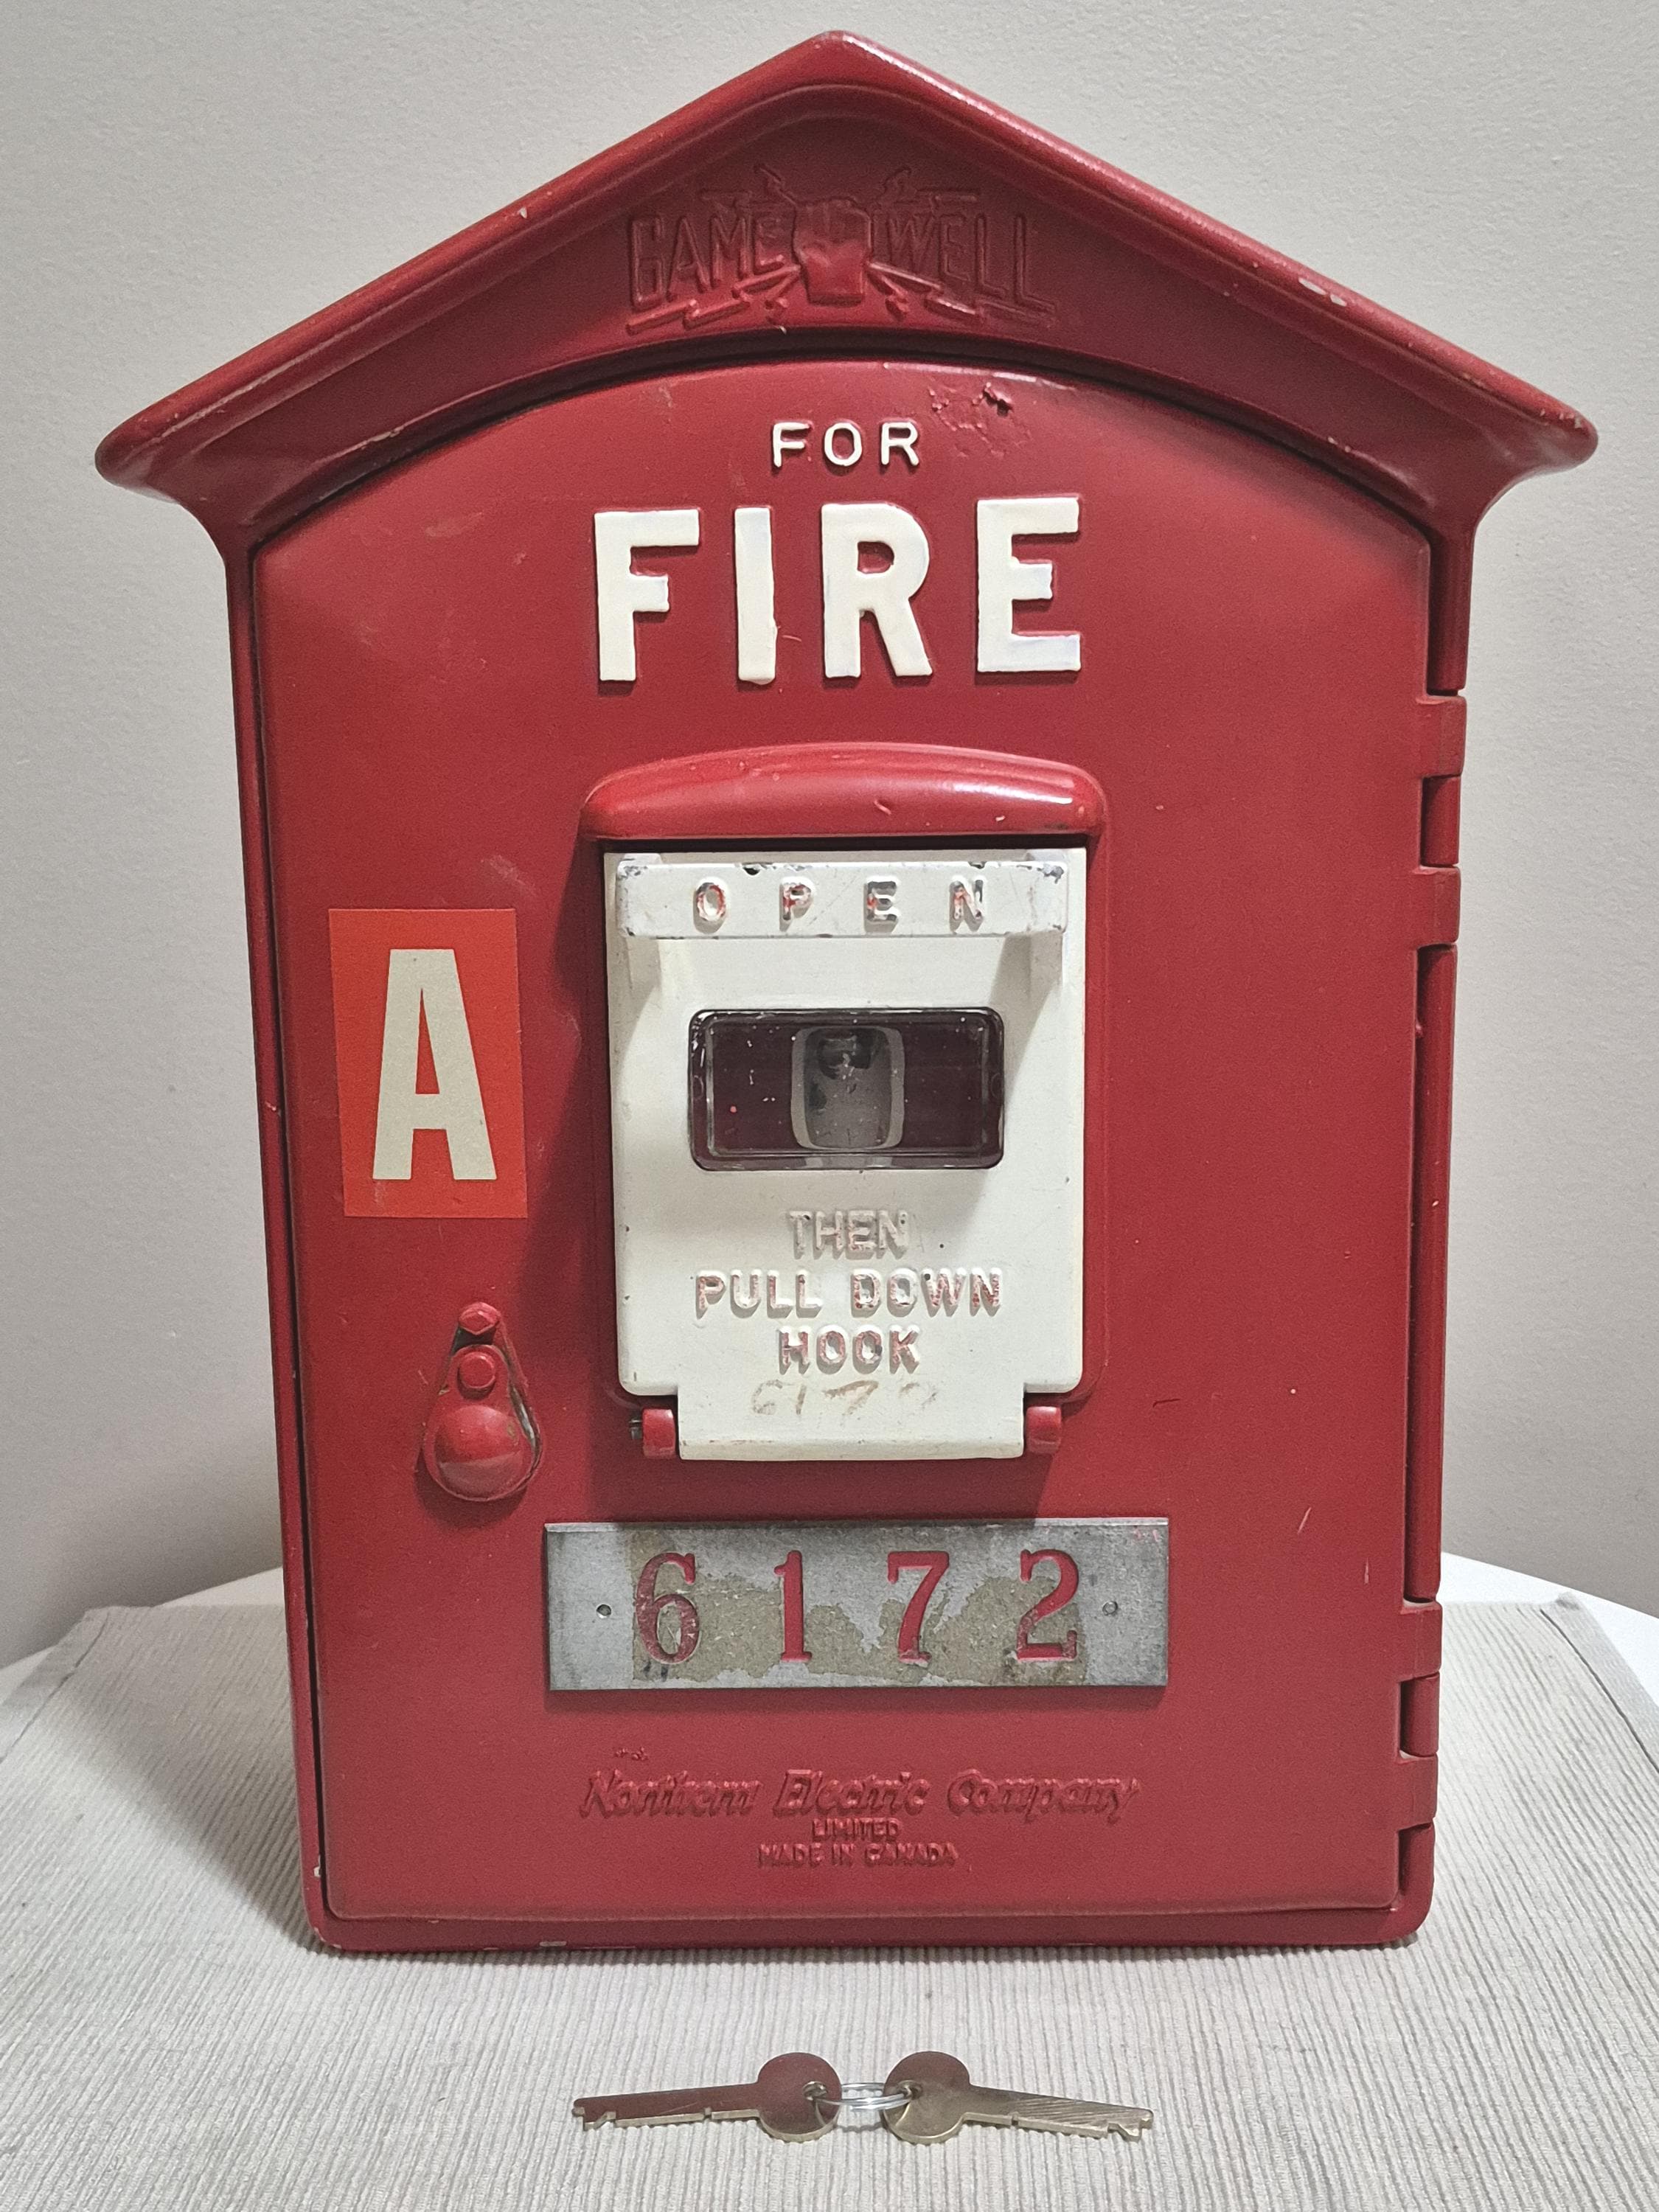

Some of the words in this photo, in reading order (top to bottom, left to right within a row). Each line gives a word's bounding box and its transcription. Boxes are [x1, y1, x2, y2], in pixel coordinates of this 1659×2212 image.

[771, 422, 921, 468] FOR
[594, 493, 1082, 684] FIRE
[693, 877, 985, 932] OPEN
[372, 948, 498, 1180] A
[787, 1209, 910, 1258] THEN
[696, 1269, 823, 1318] PULL
[850, 1267, 1003, 1317] DOWN
[779, 1324, 921, 1374] HOOK
[634, 1548, 1079, 1664] 6172
[581, 1770, 762, 1818] Northern
[773, 1768, 932, 1818] Electric
[946, 1769, 1141, 1823] Company
[757, 1843, 824, 1868] MADE
[832, 1842, 855, 1866] IN
[864, 1841, 960, 1867] CANADA
[812, 1818, 902, 1841] LIMITED
